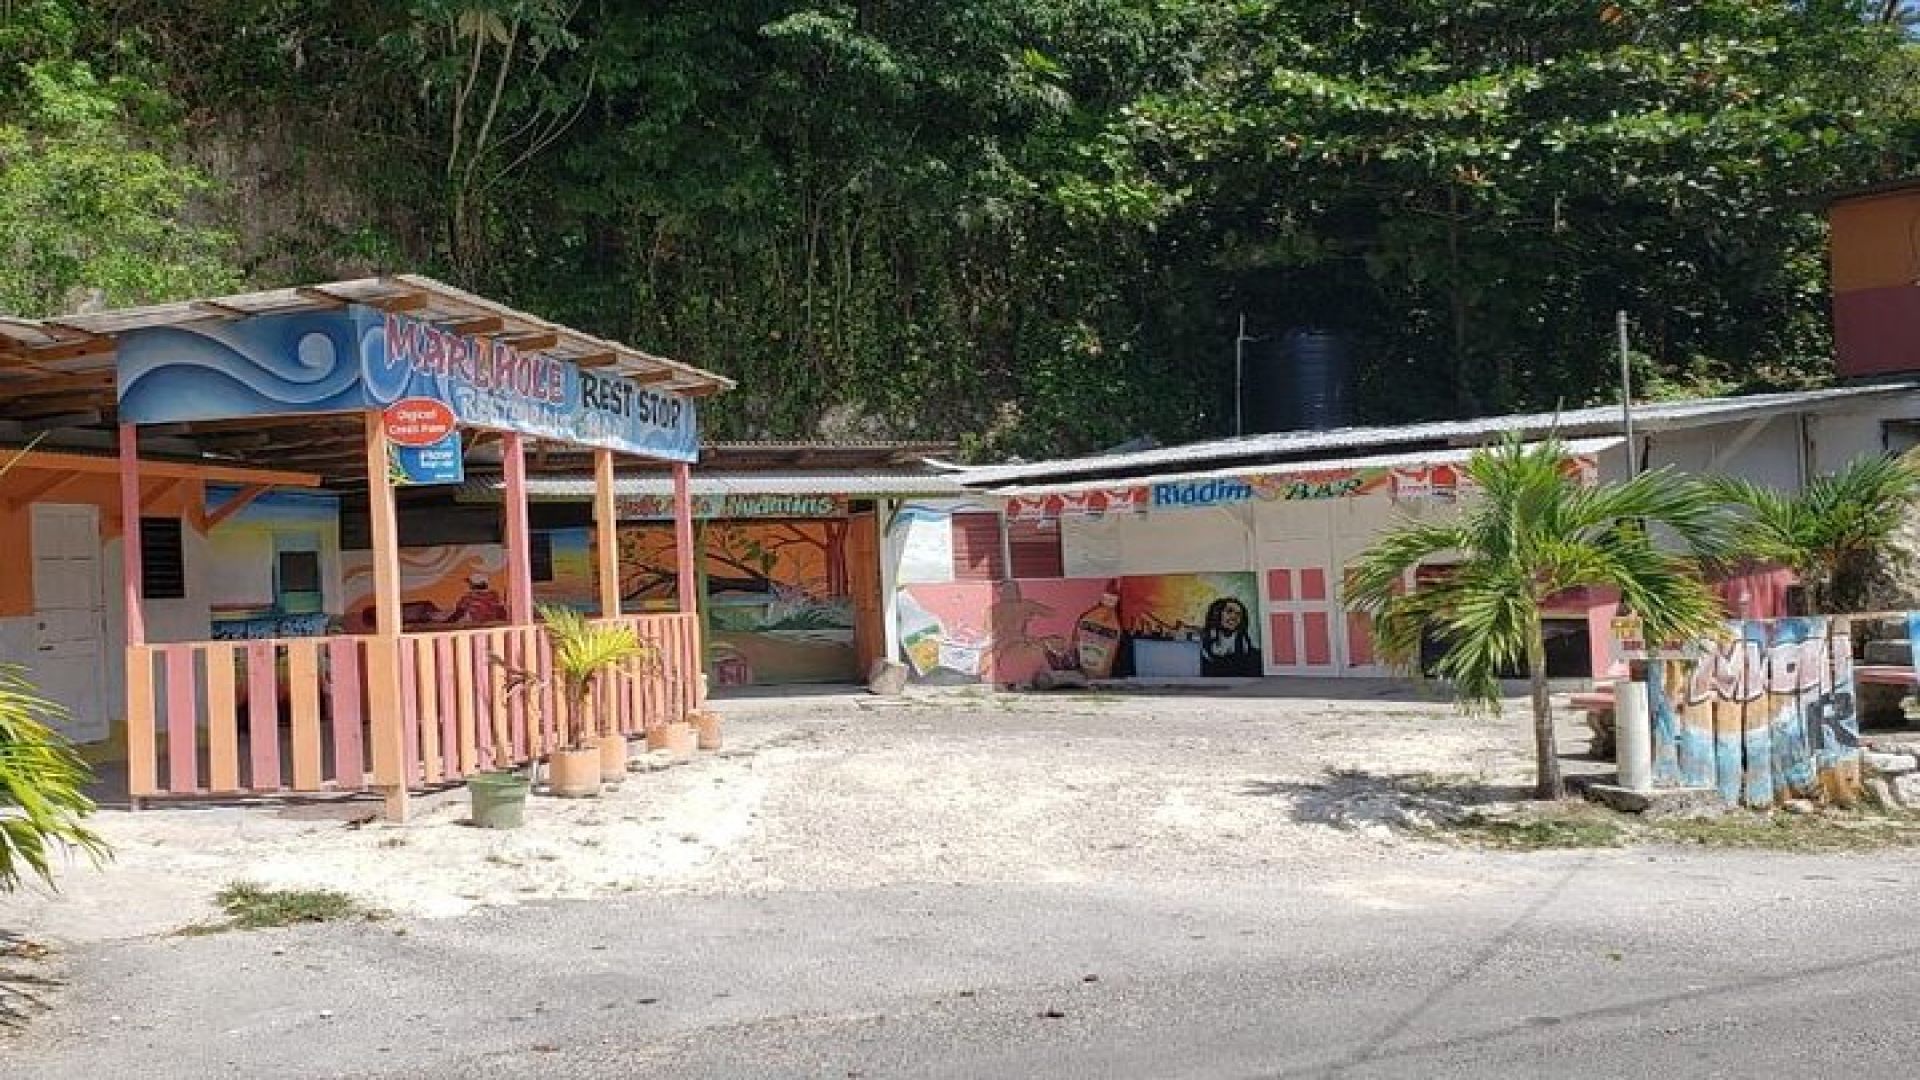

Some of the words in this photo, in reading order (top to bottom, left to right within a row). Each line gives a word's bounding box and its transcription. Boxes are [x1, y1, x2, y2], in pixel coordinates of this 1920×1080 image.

[580, 371, 632, 417] REST
[638, 388, 681, 430] STOP
[1154, 477, 1251, 506] Riddim
